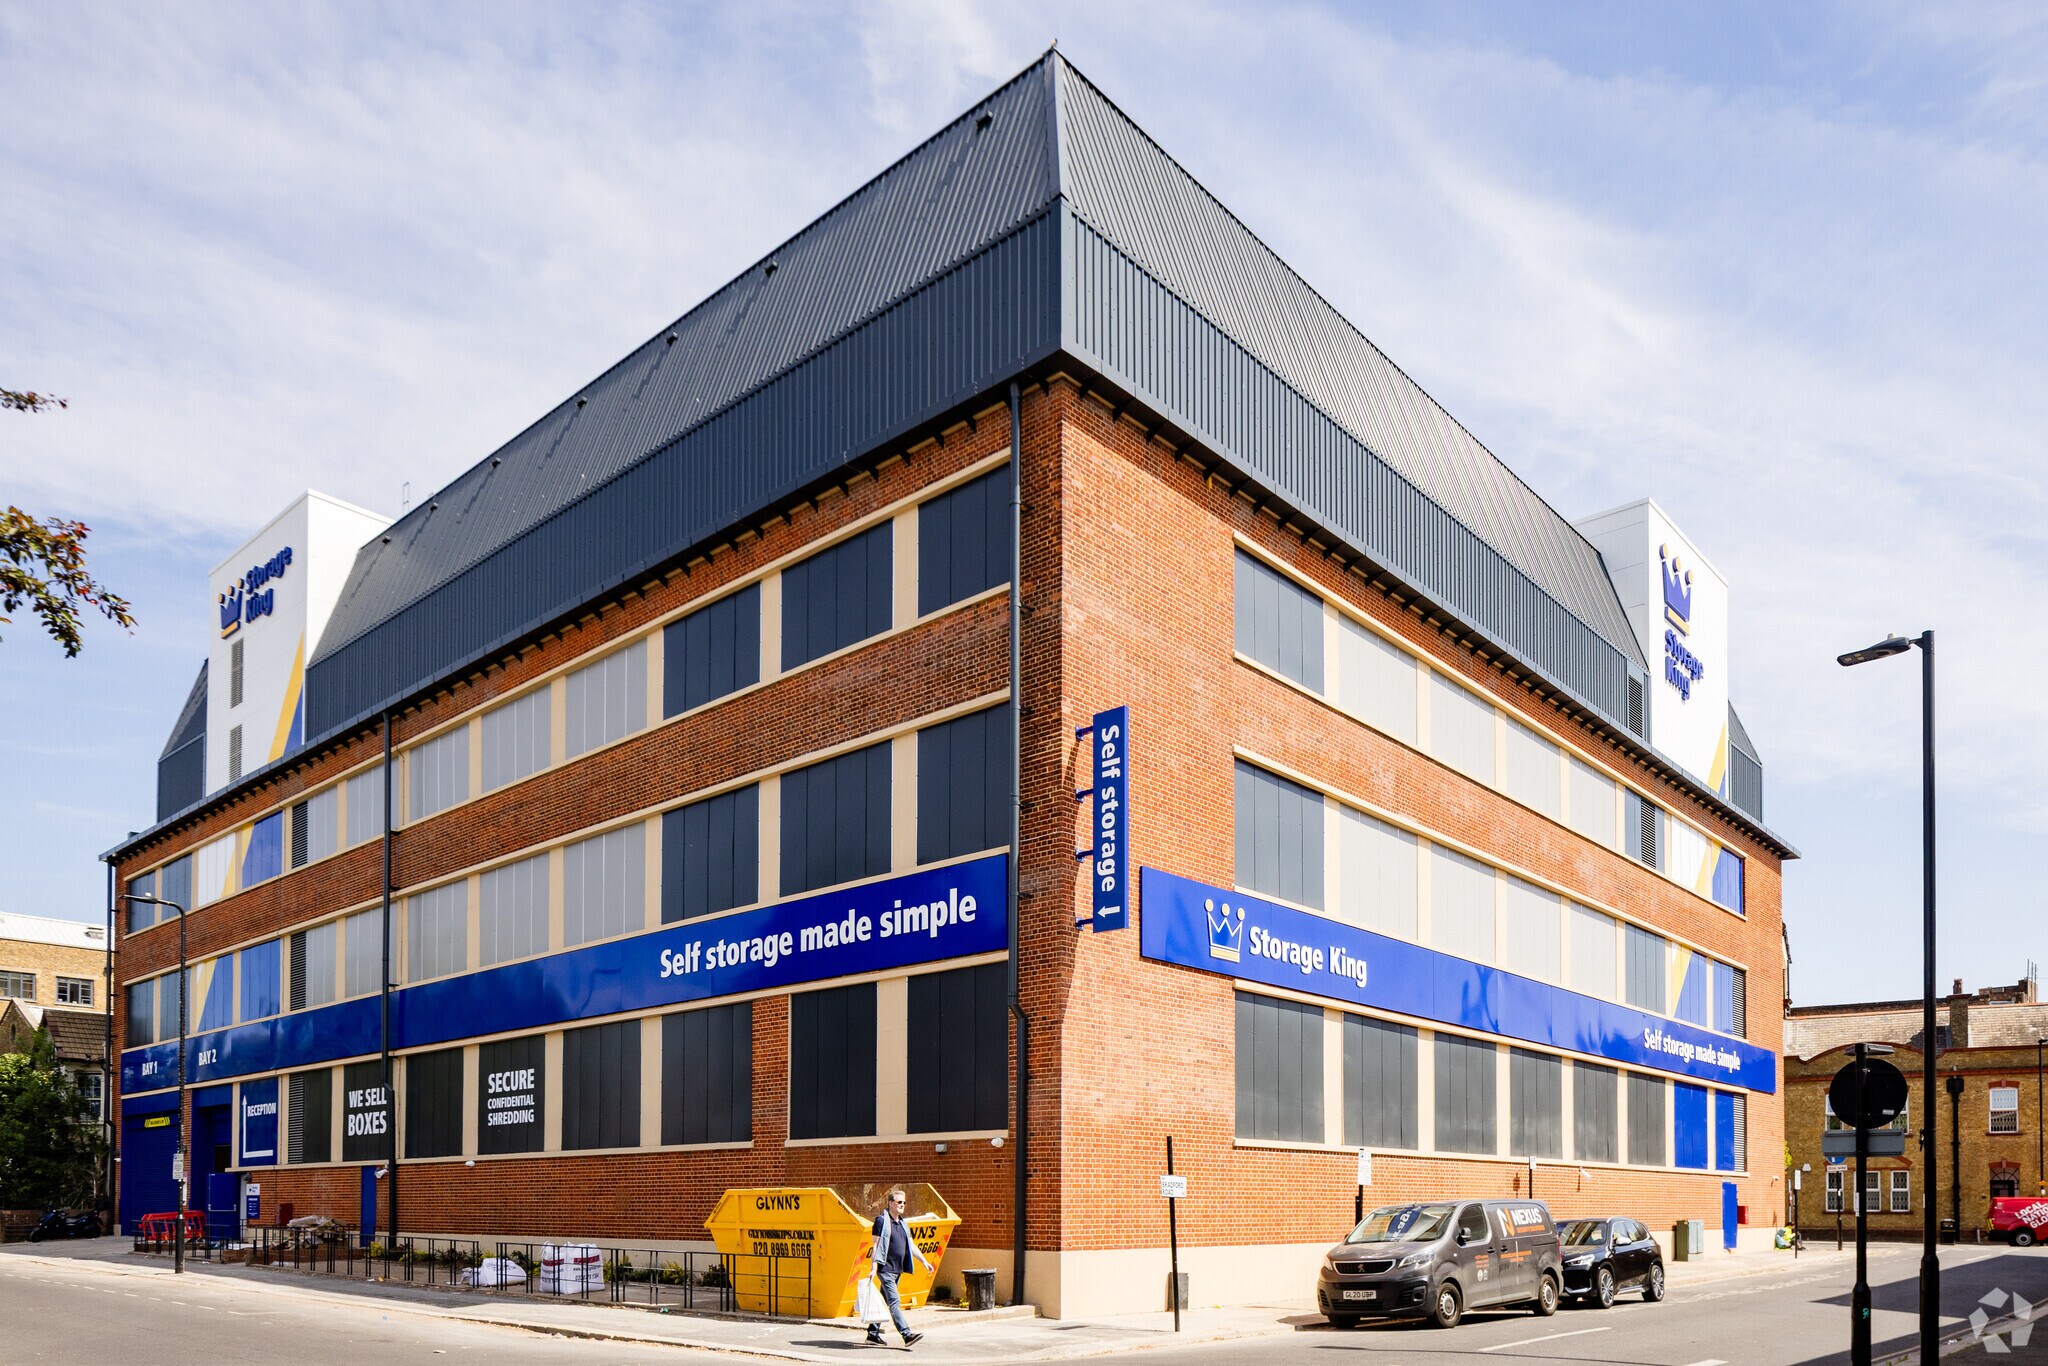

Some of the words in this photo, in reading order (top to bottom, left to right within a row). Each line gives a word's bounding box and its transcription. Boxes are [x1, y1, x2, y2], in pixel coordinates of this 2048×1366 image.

[245, 546, 293, 595] Storage
[245, 588, 274, 624] King
[1664, 629, 1704, 681] Storage
[1664, 655, 1690, 701] King
[1101, 724, 1121, 779] Self
[1096, 786, 1119, 892] storage
[660, 941, 701, 978] Self
[705, 930, 793, 968] storage
[800, 909, 872, 953] made
[879, 887, 977, 938] simple
[1249, 926, 1324, 974] Storage
[1329, 946, 1367, 988] King
[198, 1050, 213, 1066] BAY
[211, 1048, 217, 1063] 2
[1644, 1028, 1663, 1051] Self
[1663, 1035, 1695, 1063] storage
[1695, 1044, 1717, 1065] made
[1717, 1047, 1741, 1073] simple
[141, 1062, 154, 1076] BAY
[487, 1068, 535, 1094] SECURE
[348, 1089, 363, 1108] WE
[365, 1087, 387, 1106] SELL
[487, 1094, 535, 1110] CONFIDENTIAL
[247, 1102, 276, 1117] RECEPTION
[487, 1109, 535, 1127] SHREDDING
[347, 1110, 387, 1136] BOXES
[755, 1194, 800, 1211] GLYNN'S
[2014, 1201, 2048, 1219] LOCAL
[1510, 1207, 1543, 1226] NEXUS
[2030, 1213, 2048, 1229] GLO
[753, 1241, 768, 1255] 020
[770, 1242, 789, 1256] 8969
[791, 1243, 812, 1257] 6666
